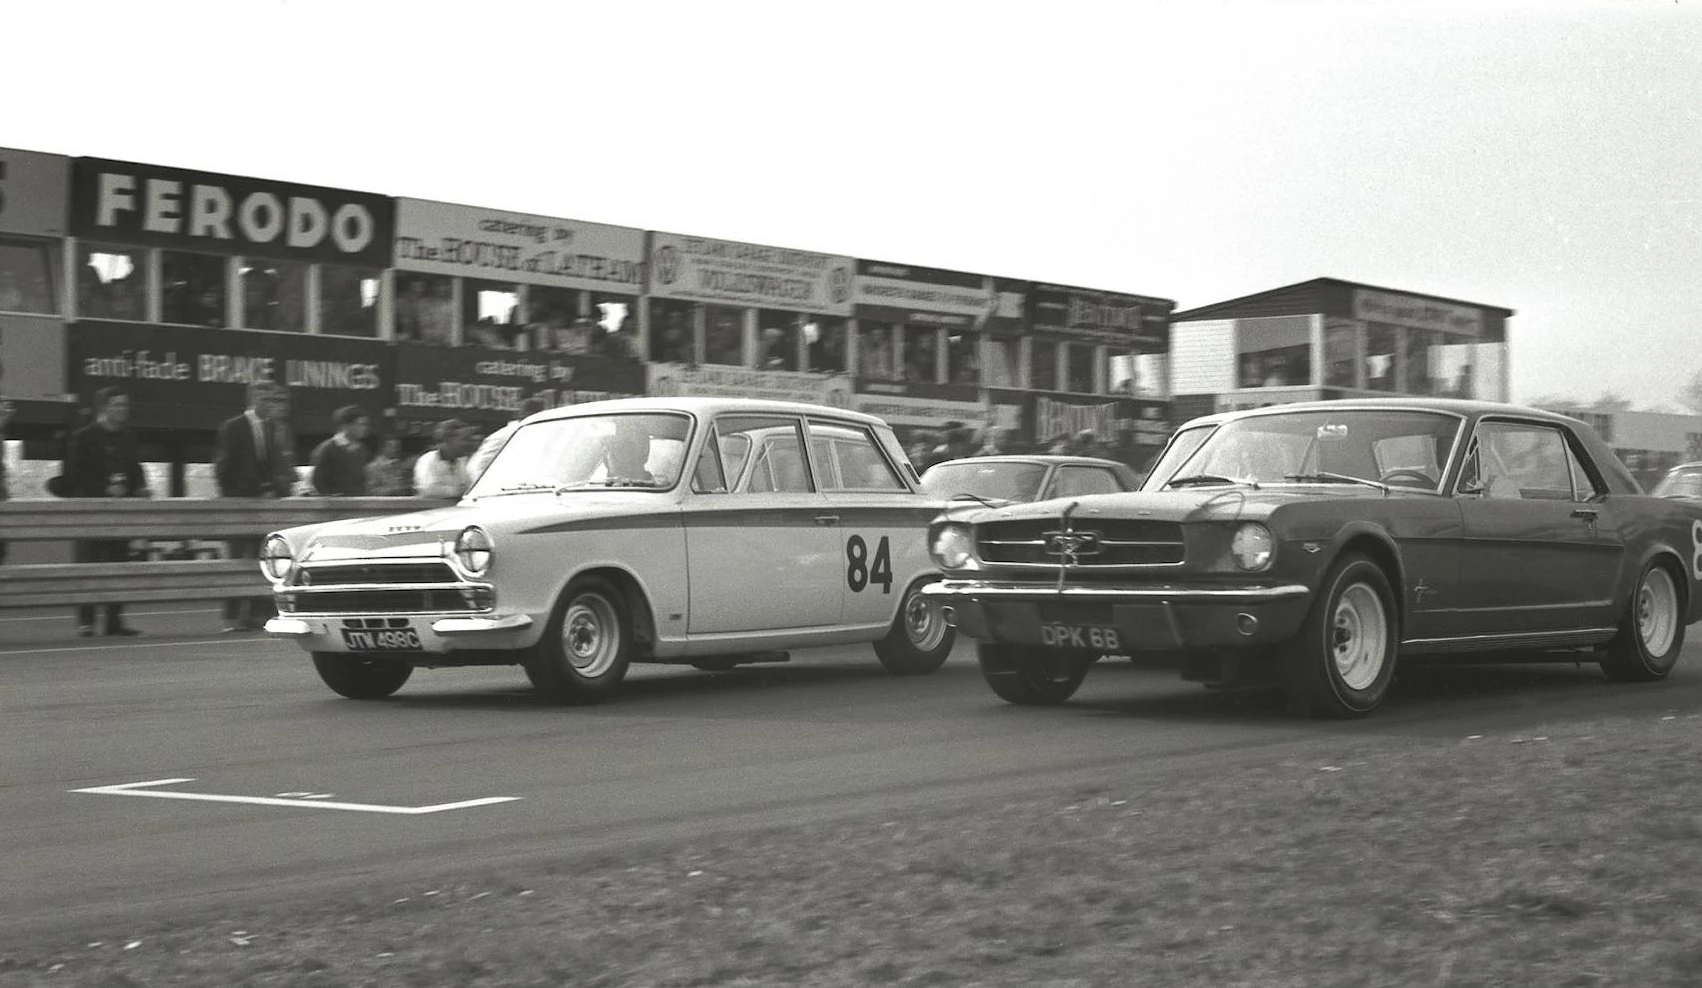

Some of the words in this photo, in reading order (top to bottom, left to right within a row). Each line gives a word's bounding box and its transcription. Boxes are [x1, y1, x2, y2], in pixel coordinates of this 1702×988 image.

[96, 173, 374, 253] FERODO
[397, 237, 438, 261] The
[441, 237, 523, 271] HOUSE
[84, 350, 190, 381] anti-fade
[198, 353, 274, 385] BRAKE
[285, 359, 380, 390] LININGS
[476, 359, 547, 383] catering
[396, 384, 438, 406] The
[439, 381, 523, 411] HOUSE
[847, 534, 892, 594] 84
[378, 631, 419, 648] 498C
[1041, 626, 1085, 647] DPK
[1089, 627, 1118, 649] 6B
